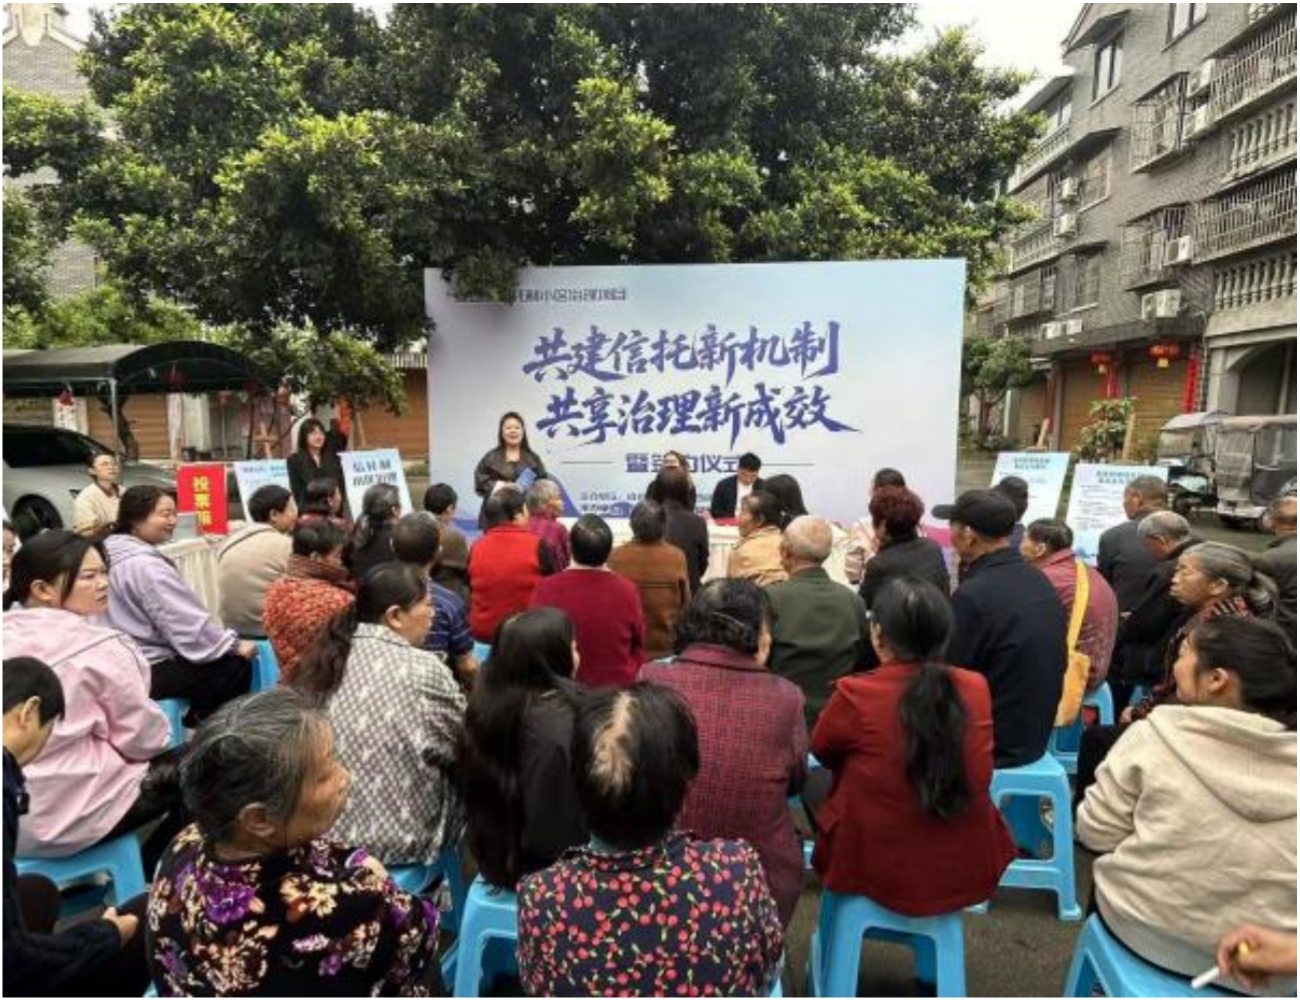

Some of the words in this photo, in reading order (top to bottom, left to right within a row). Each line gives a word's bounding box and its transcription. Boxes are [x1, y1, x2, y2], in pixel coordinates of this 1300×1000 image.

[522, 320, 840, 385] 共建信托新机制
[536, 382, 864, 449] 共享治理新成效
